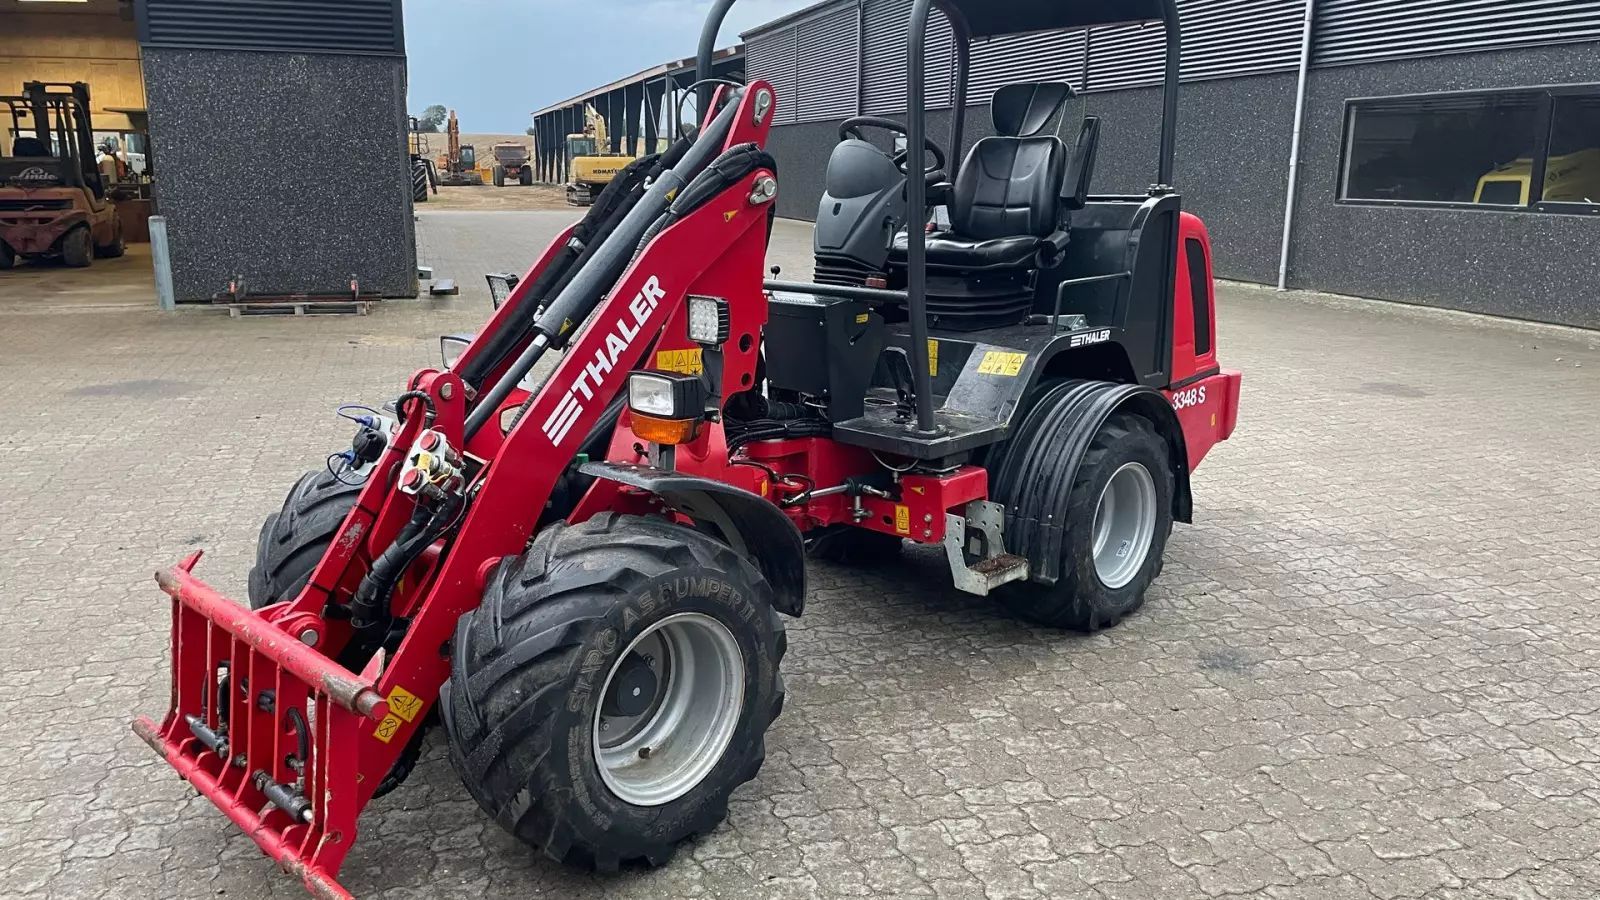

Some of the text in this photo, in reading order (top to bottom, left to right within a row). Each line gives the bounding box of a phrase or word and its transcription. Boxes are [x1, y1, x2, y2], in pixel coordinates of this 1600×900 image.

[9, 166, 58, 180] Linde
[570, 274, 667, 402] THALER
[1080, 329, 1111, 345] THALER
[1172, 385, 1206, 410] 3348 S
